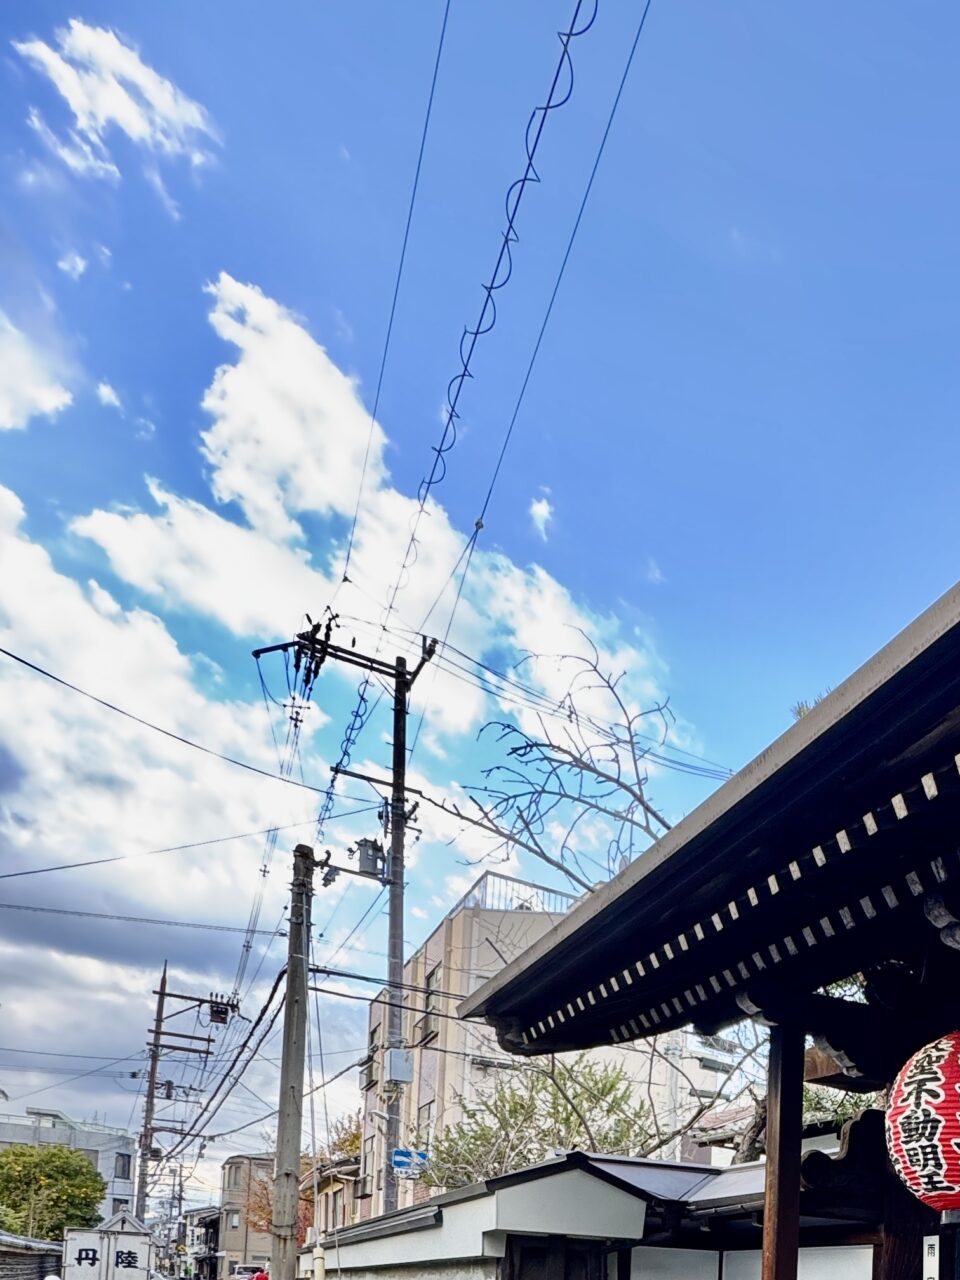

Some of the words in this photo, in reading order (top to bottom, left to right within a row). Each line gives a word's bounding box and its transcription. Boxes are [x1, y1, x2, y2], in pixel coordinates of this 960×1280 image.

[897, 1039, 955, 1193] 大聖不動明王
